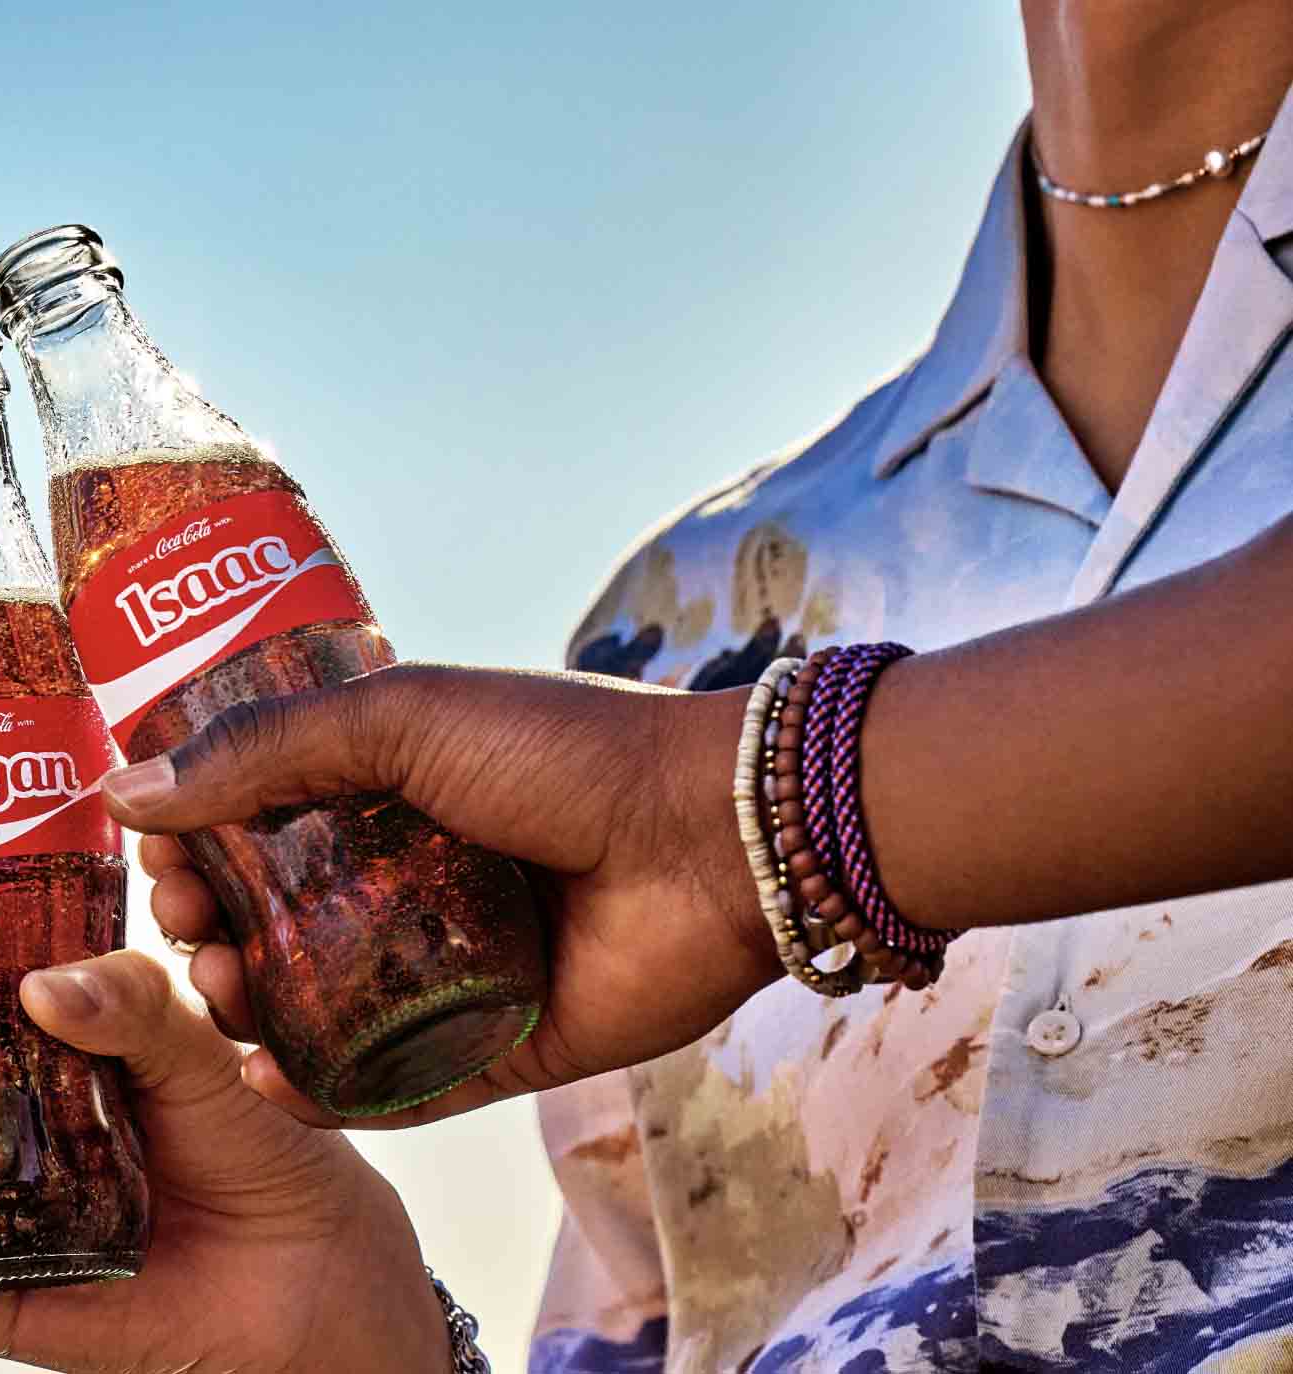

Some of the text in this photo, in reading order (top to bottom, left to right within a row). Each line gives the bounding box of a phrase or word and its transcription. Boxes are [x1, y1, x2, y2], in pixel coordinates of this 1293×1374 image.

[155, 517, 211, 560] Coca-Cola
[115, 535, 297, 647] Isaac
[17, 718, 35, 728] with
